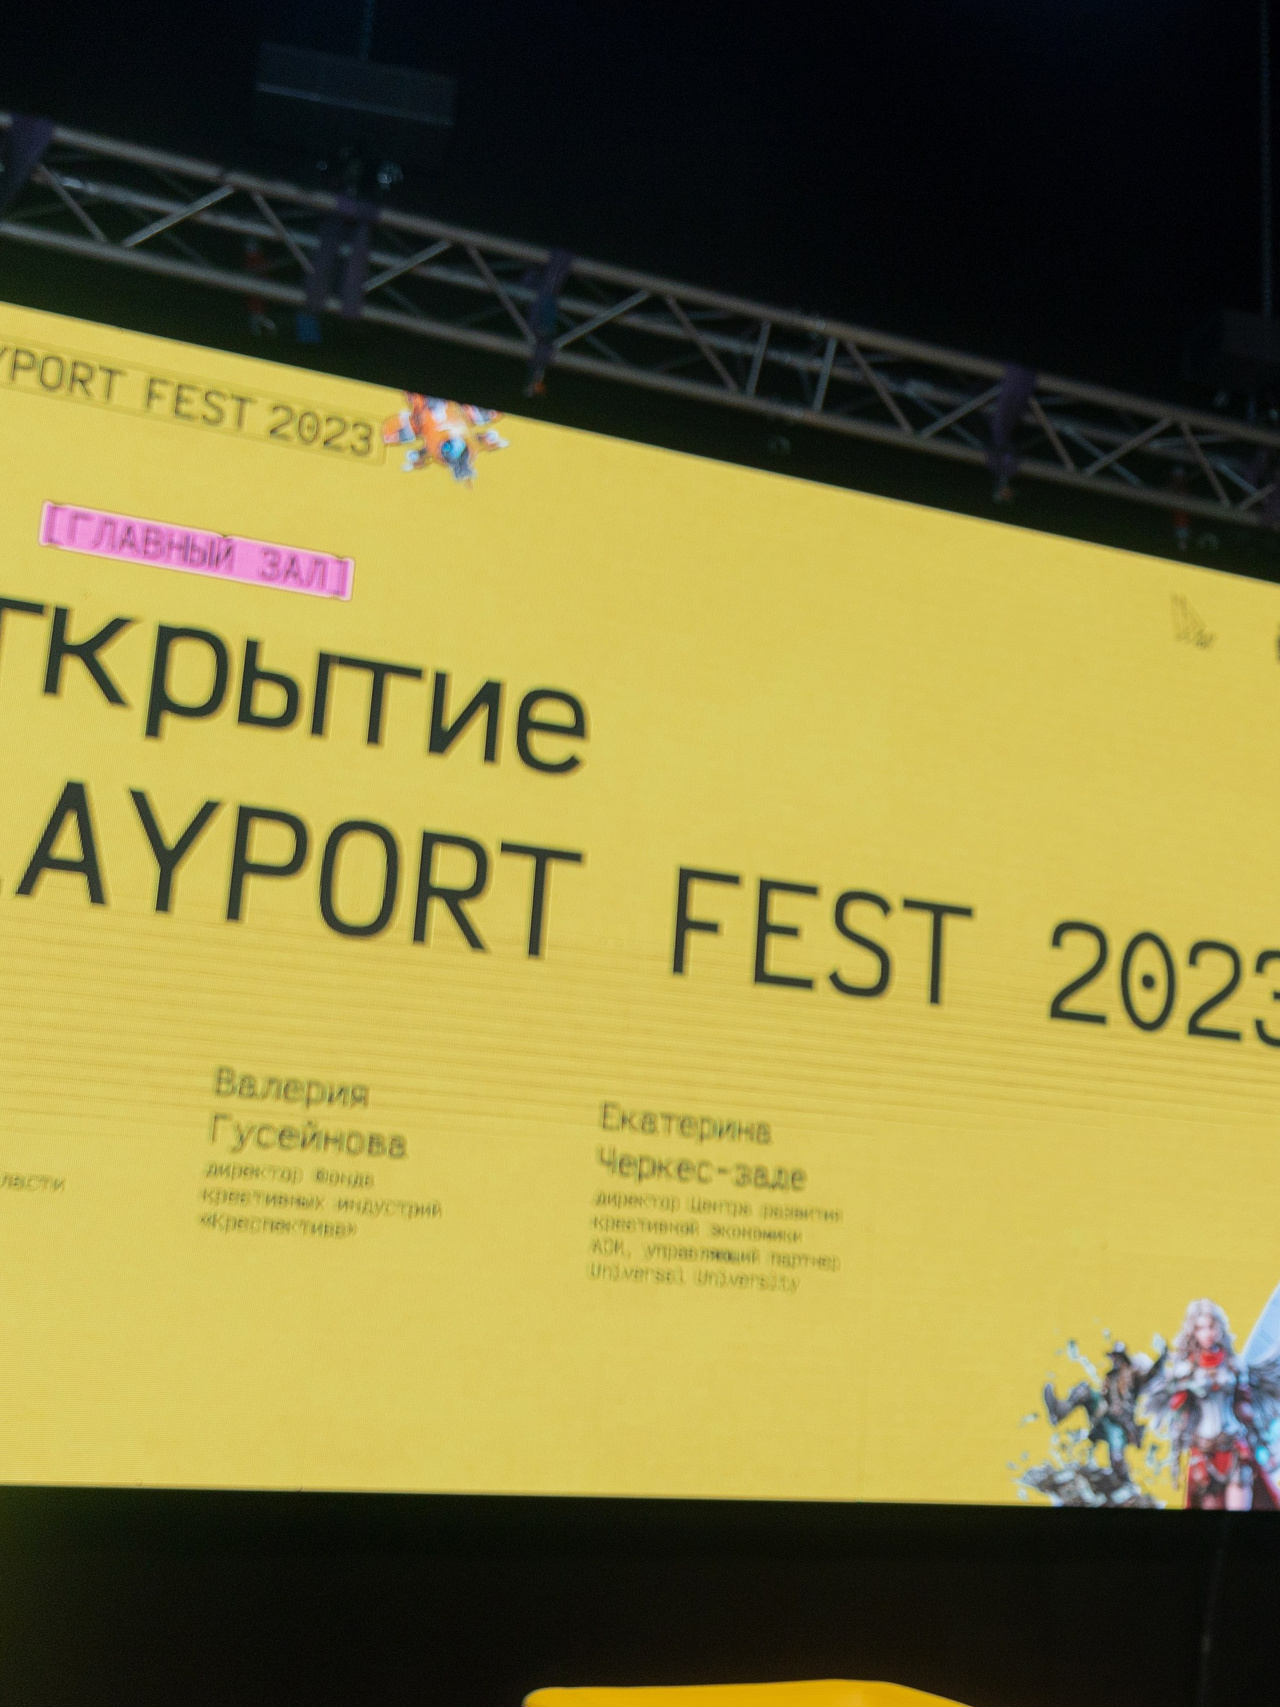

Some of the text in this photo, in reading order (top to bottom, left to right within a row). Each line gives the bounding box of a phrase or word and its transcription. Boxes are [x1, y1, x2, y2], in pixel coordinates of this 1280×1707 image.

[146, 376, 258, 431] FEST
[269, 404, 372, 457] 2023
[259, 546, 350, 598] ЗАЛ]
[673, 866, 974, 1007] FEST
[214, 1066, 370, 1109] Валерия
[210, 1113, 406, 1160] Гусейнова
[602, 1101, 771, 1146] Екатерина
[597, 1147, 806, 1191] Черкес-заде
